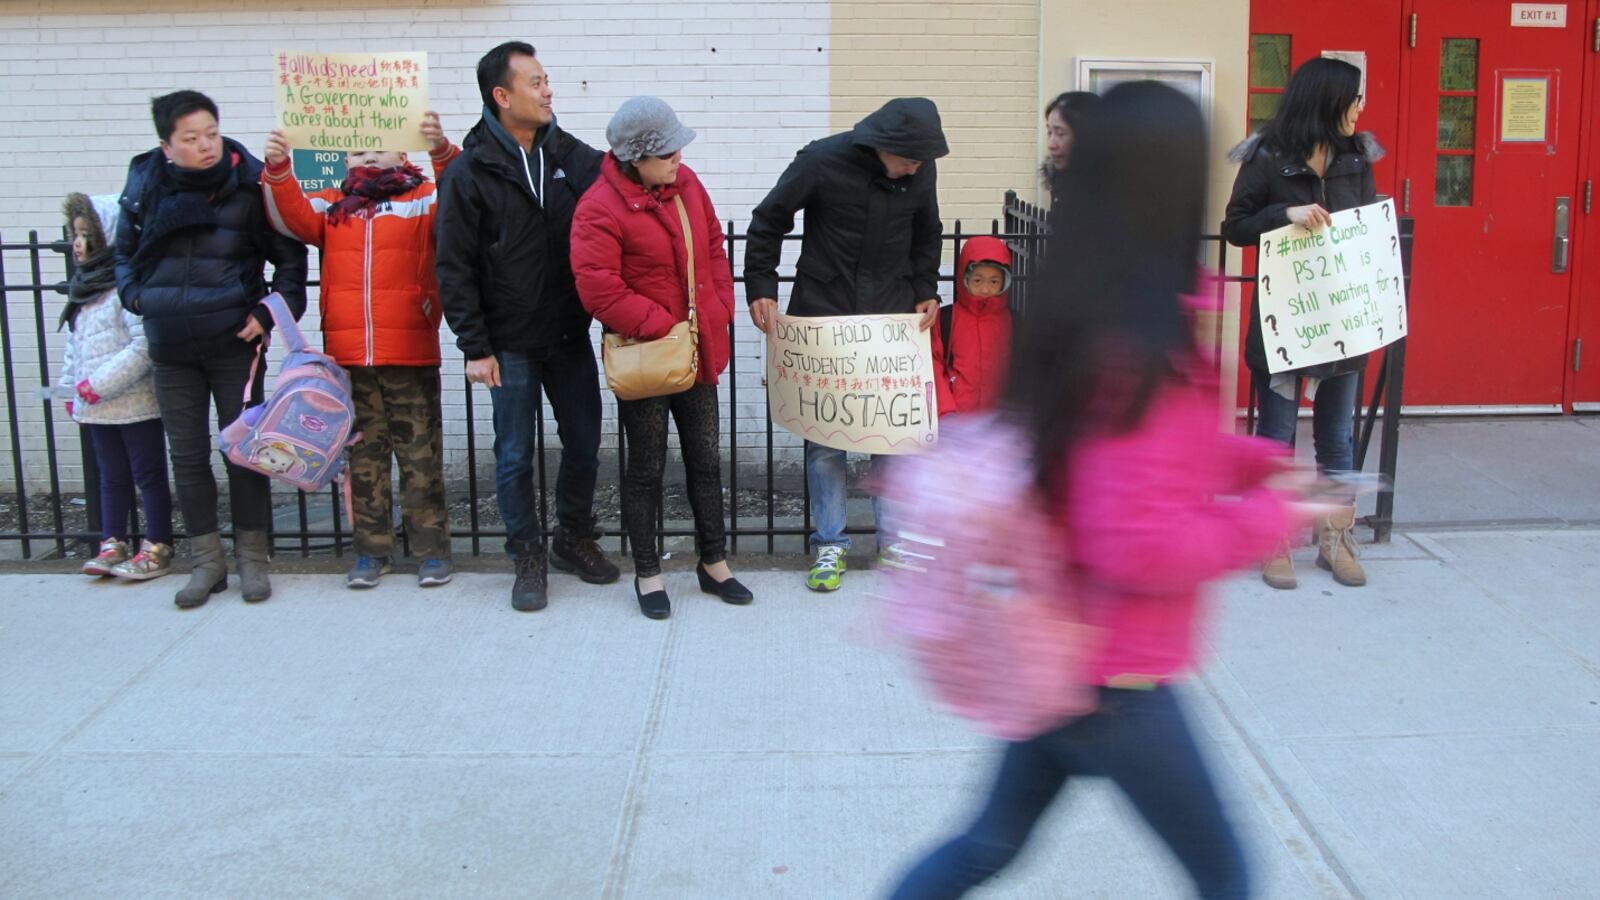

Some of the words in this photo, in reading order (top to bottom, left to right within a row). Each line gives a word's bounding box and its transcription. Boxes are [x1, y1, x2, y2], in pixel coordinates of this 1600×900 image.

[1521, 10, 1543, 20] EXIT
[1545, 10, 1557, 20] #1
[286, 85, 295, 104] A
[300, 85, 375, 107] Governor
[379, 87, 409, 108] who
[283, 110, 321, 127] cares
[324, 108, 366, 129] about
[369, 109, 408, 130] their
[310, 130, 382, 149] education
[315, 152, 339, 162] ROD
[322, 166, 334, 175] IN
[1292, 259, 1315, 284] PS
[1316, 255, 1332, 278] 2
[1334, 251, 1348, 274] M
[1360, 249, 1371, 267] is
[1328, 283, 1371, 306] waiting
[1376, 268, 1390, 295] for
[776, 320, 823, 346] DON'T
[832, 323, 872, 346] HOLD
[883, 322, 910, 344] OUR
[1295, 322, 1331, 349] your
[782, 350, 858, 376] STUDENTS'
[865, 353, 917, 375] MONEY
